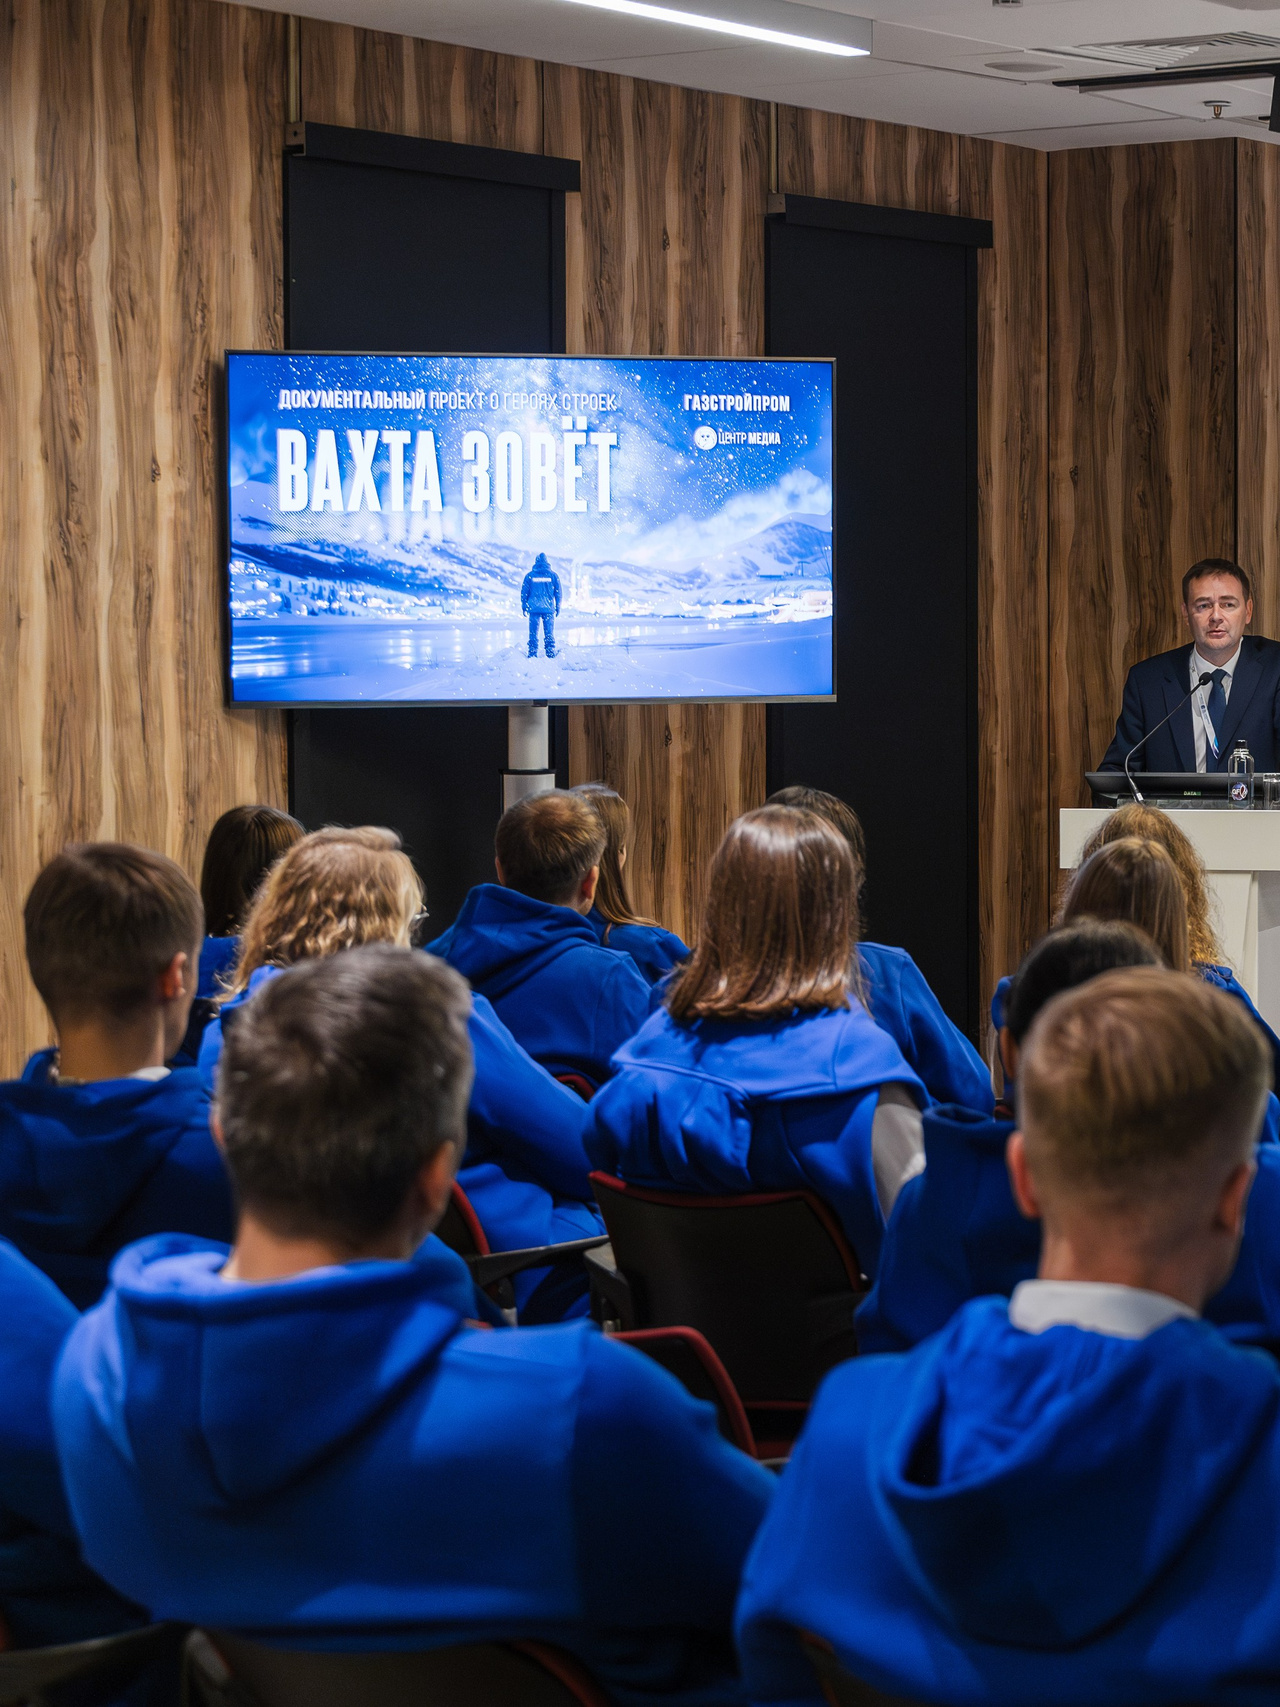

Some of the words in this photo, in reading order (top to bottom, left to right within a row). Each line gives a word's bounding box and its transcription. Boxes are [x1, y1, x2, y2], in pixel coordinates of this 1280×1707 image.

[278, 388, 426, 411] ДОКУМЕНТАЛЬНЫЙ
[430, 391, 485, 411] ПРОЕКТ
[490, 392, 499, 411] О
[503, 392, 558, 412] ГЕРОЯХ
[562, 392, 617, 412] СТРОЕК
[684, 393, 791, 412] ГАЗСТРОЙПРОМ
[718, 431, 747, 445] ЦЕНТР
[748, 431, 781, 446] МЕДИА
[277, 427, 443, 514] ВАХТА
[462, 415, 618, 514] ЗОВЁТ
